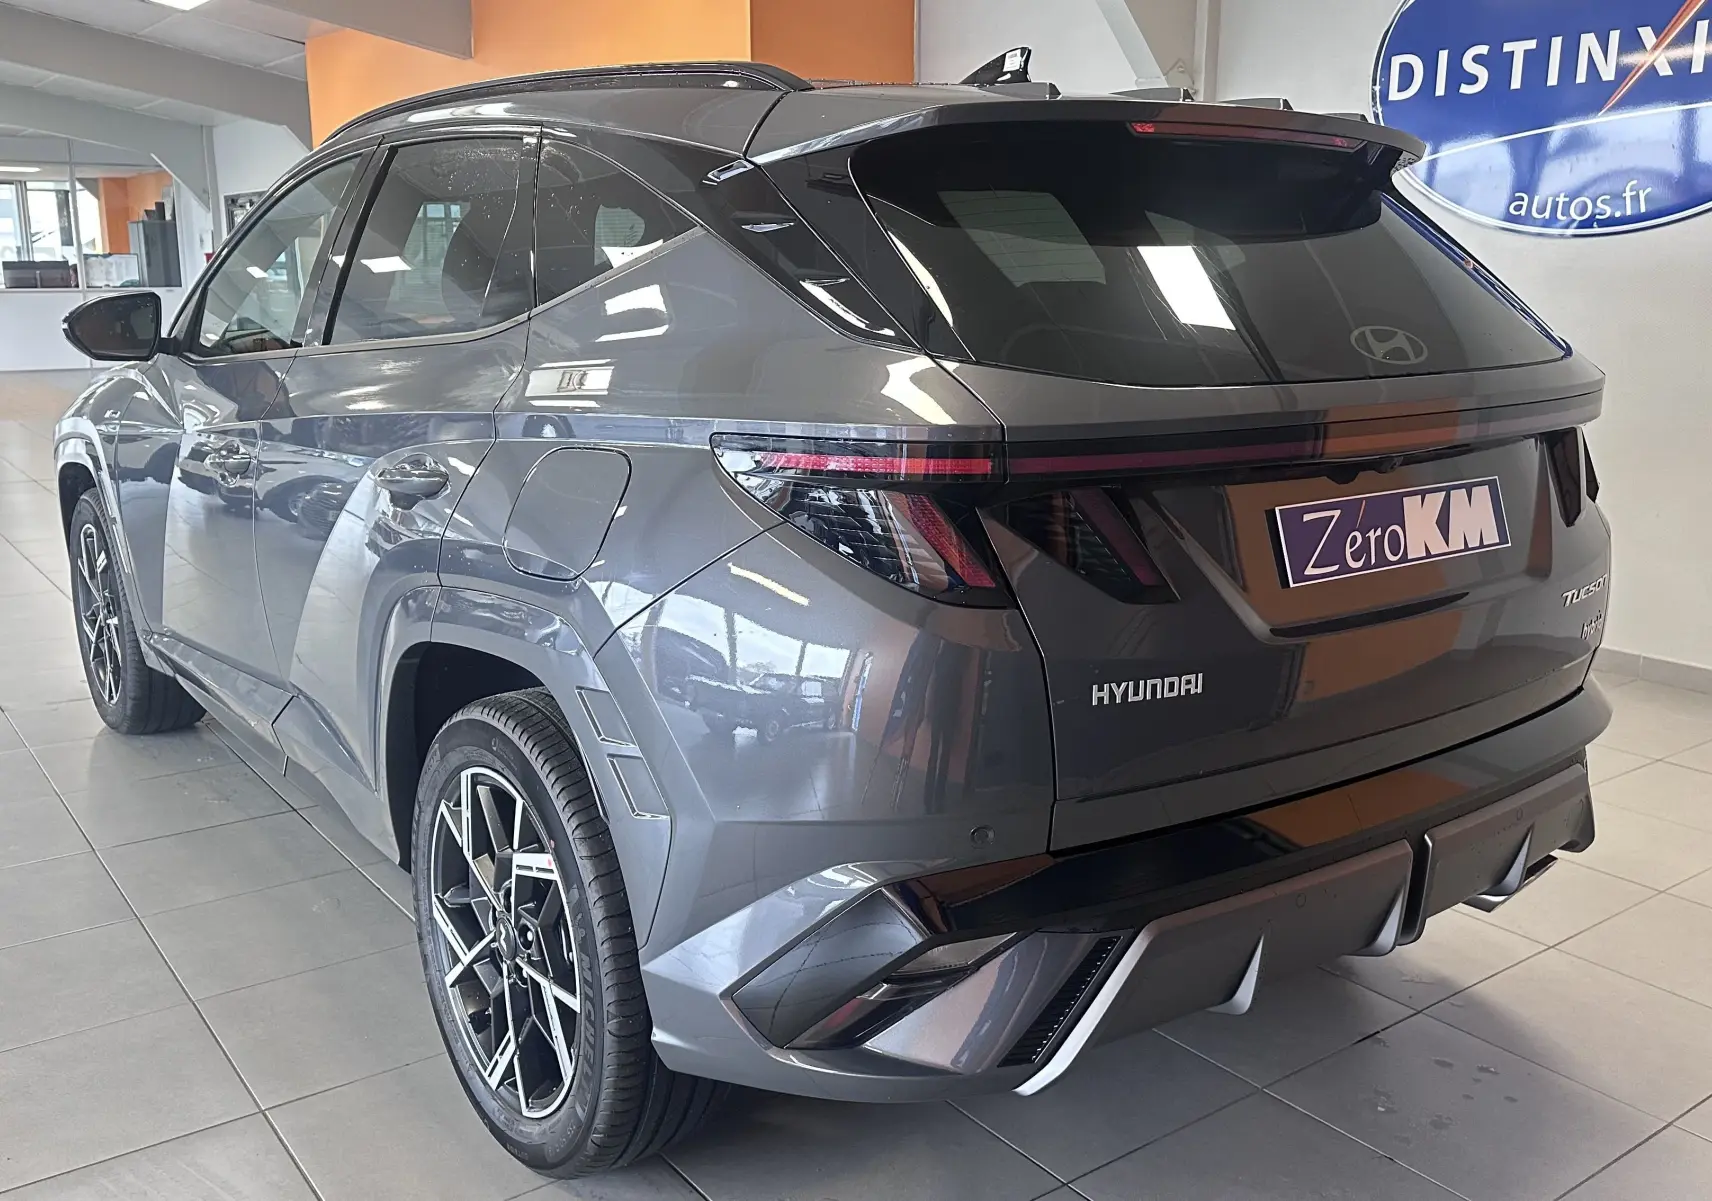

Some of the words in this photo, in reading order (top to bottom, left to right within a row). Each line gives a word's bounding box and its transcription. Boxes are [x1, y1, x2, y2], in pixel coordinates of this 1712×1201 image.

[1388, 19, 1711, 101] DISTINXI
[1508, 180, 1652, 222] autos.fr
[1092, 672, 1203, 706] HYUNDAI
[575, 951, 595, 1122] MICHELIN
